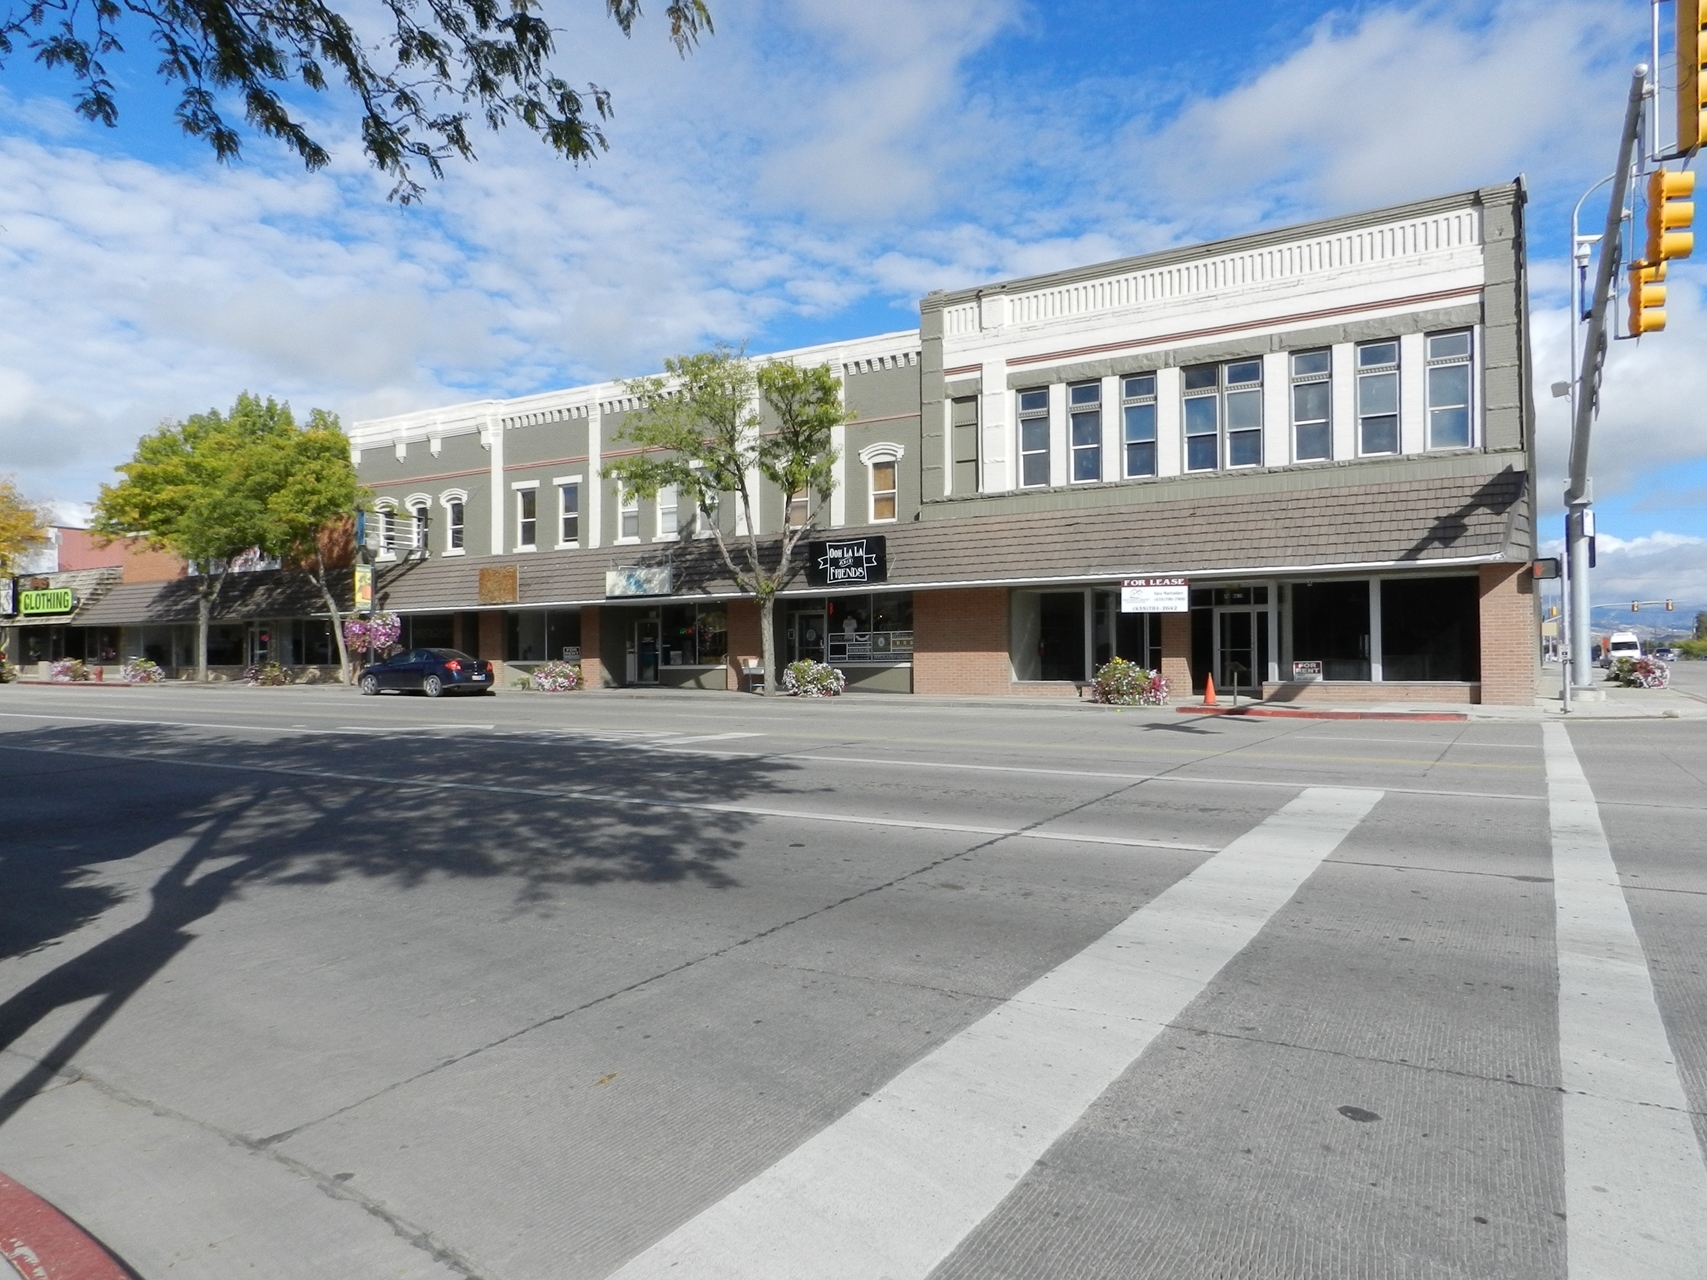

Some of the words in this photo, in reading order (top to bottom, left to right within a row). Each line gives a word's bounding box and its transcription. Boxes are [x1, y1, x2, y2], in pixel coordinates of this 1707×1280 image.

[829, 548, 843, 558] OOH
[844, 547, 853, 557] LA
[854, 546, 864, 557] LA
[830, 566, 865, 580] FRIENDS
[1123, 579, 1147, 587] FOR
[1149, 578, 1185, 586] LEASE
[24, 591, 70, 611] CLOTHING
